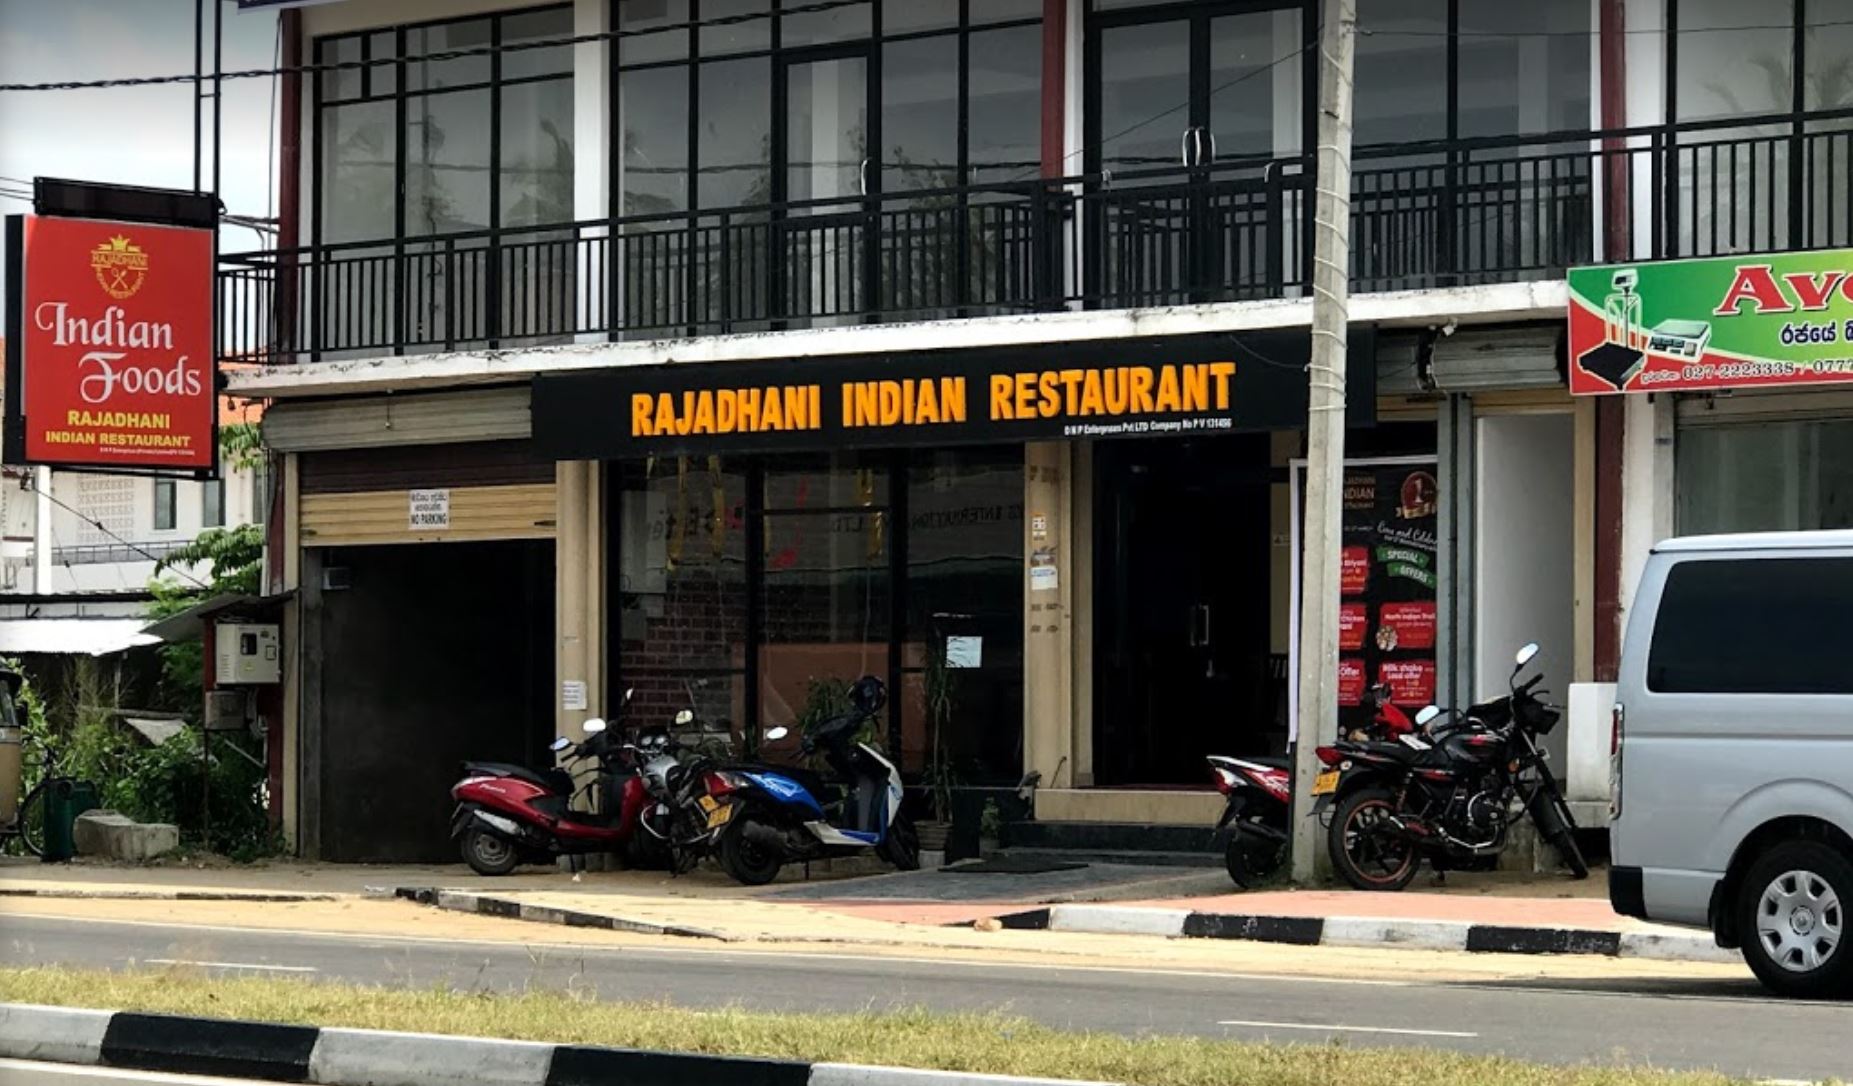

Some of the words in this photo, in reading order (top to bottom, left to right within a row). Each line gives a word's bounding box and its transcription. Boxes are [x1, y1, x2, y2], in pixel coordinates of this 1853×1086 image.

[35, 302, 175, 349] Indian
[78, 352, 202, 403] Foods
[631, 384, 821, 437] RAJADHANI
[842, 376, 966, 427] INDIAN
[990, 362, 1236, 421] RESTAURANT
[67, 409, 171, 429] RAJADHANI
[46, 431, 96, 444] INDIAN
[100, 432, 191, 447] RESTAURANT
[1387, 550, 1418, 563] SPECIAL
